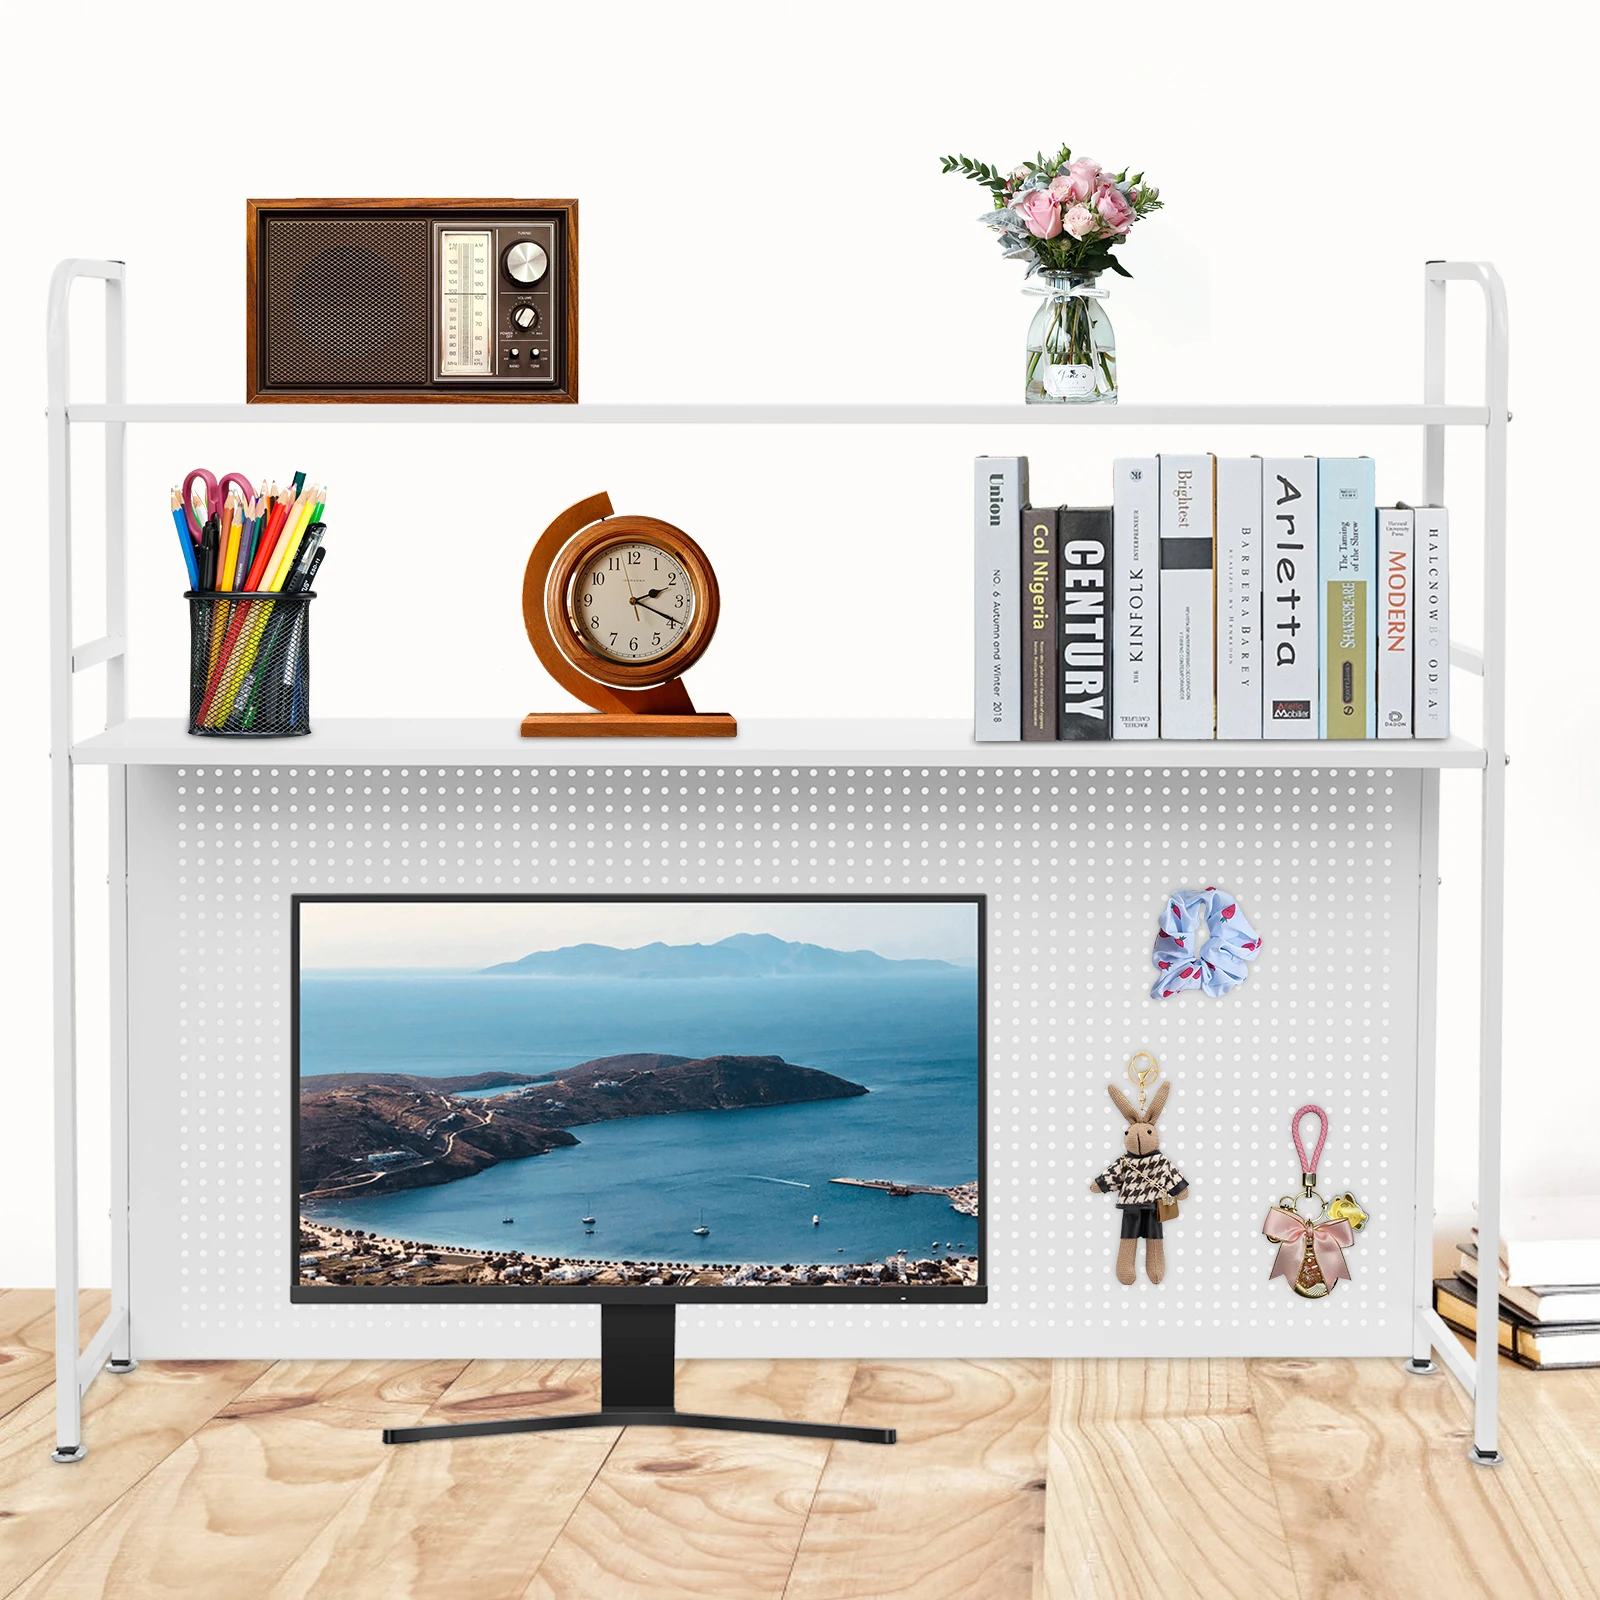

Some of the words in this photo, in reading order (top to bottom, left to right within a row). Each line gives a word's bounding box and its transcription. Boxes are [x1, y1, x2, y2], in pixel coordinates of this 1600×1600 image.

[989, 473, 1004, 527] Union
[1173, 470, 1193, 528] Brightest
[1033, 524, 1049, 554] Col
[1338, 521, 1350, 552] Taming
[1350, 520, 1360, 546] Shrew
[608, 558, 620, 570] 11
[627, 552, 641, 564] 12
[653, 558, 659, 570] 1
[1339, 554, 1348, 572] The
[1350, 548, 1360, 562] the
[1241, 527, 1252, 617] BARBERA
[1276, 474, 1304, 667] Arletta
[1350, 562, 1360, 572] of
[592, 572, 605, 586] 10
[668, 572, 676, 586] 2
[993, 569, 1001, 586] NO.
[584, 594, 592, 608] 9
[674, 594, 684, 608] 3
[1028, 561, 1049, 630] Nigeria
[1388, 551, 1406, 652] MODERN
[590, 616, 600, 629] 8
[666, 616, 676, 630] 4
[992, 602, 1002, 639] Autumn
[1129, 568, 1144, 662] KINFOLK
[1340, 582, 1356, 648] SHAKESPEARE
[610, 632, 618, 646] 7
[652, 632, 661, 646] 5
[1064, 540, 1105, 720] CENTURY
[630, 637, 638, 651] 6
[992, 641, 1002, 660] and
[1241, 626, 1252, 688] BAREY
[993, 664, 1002, 696] Winter
[993, 702, 1002, 723] 2018
